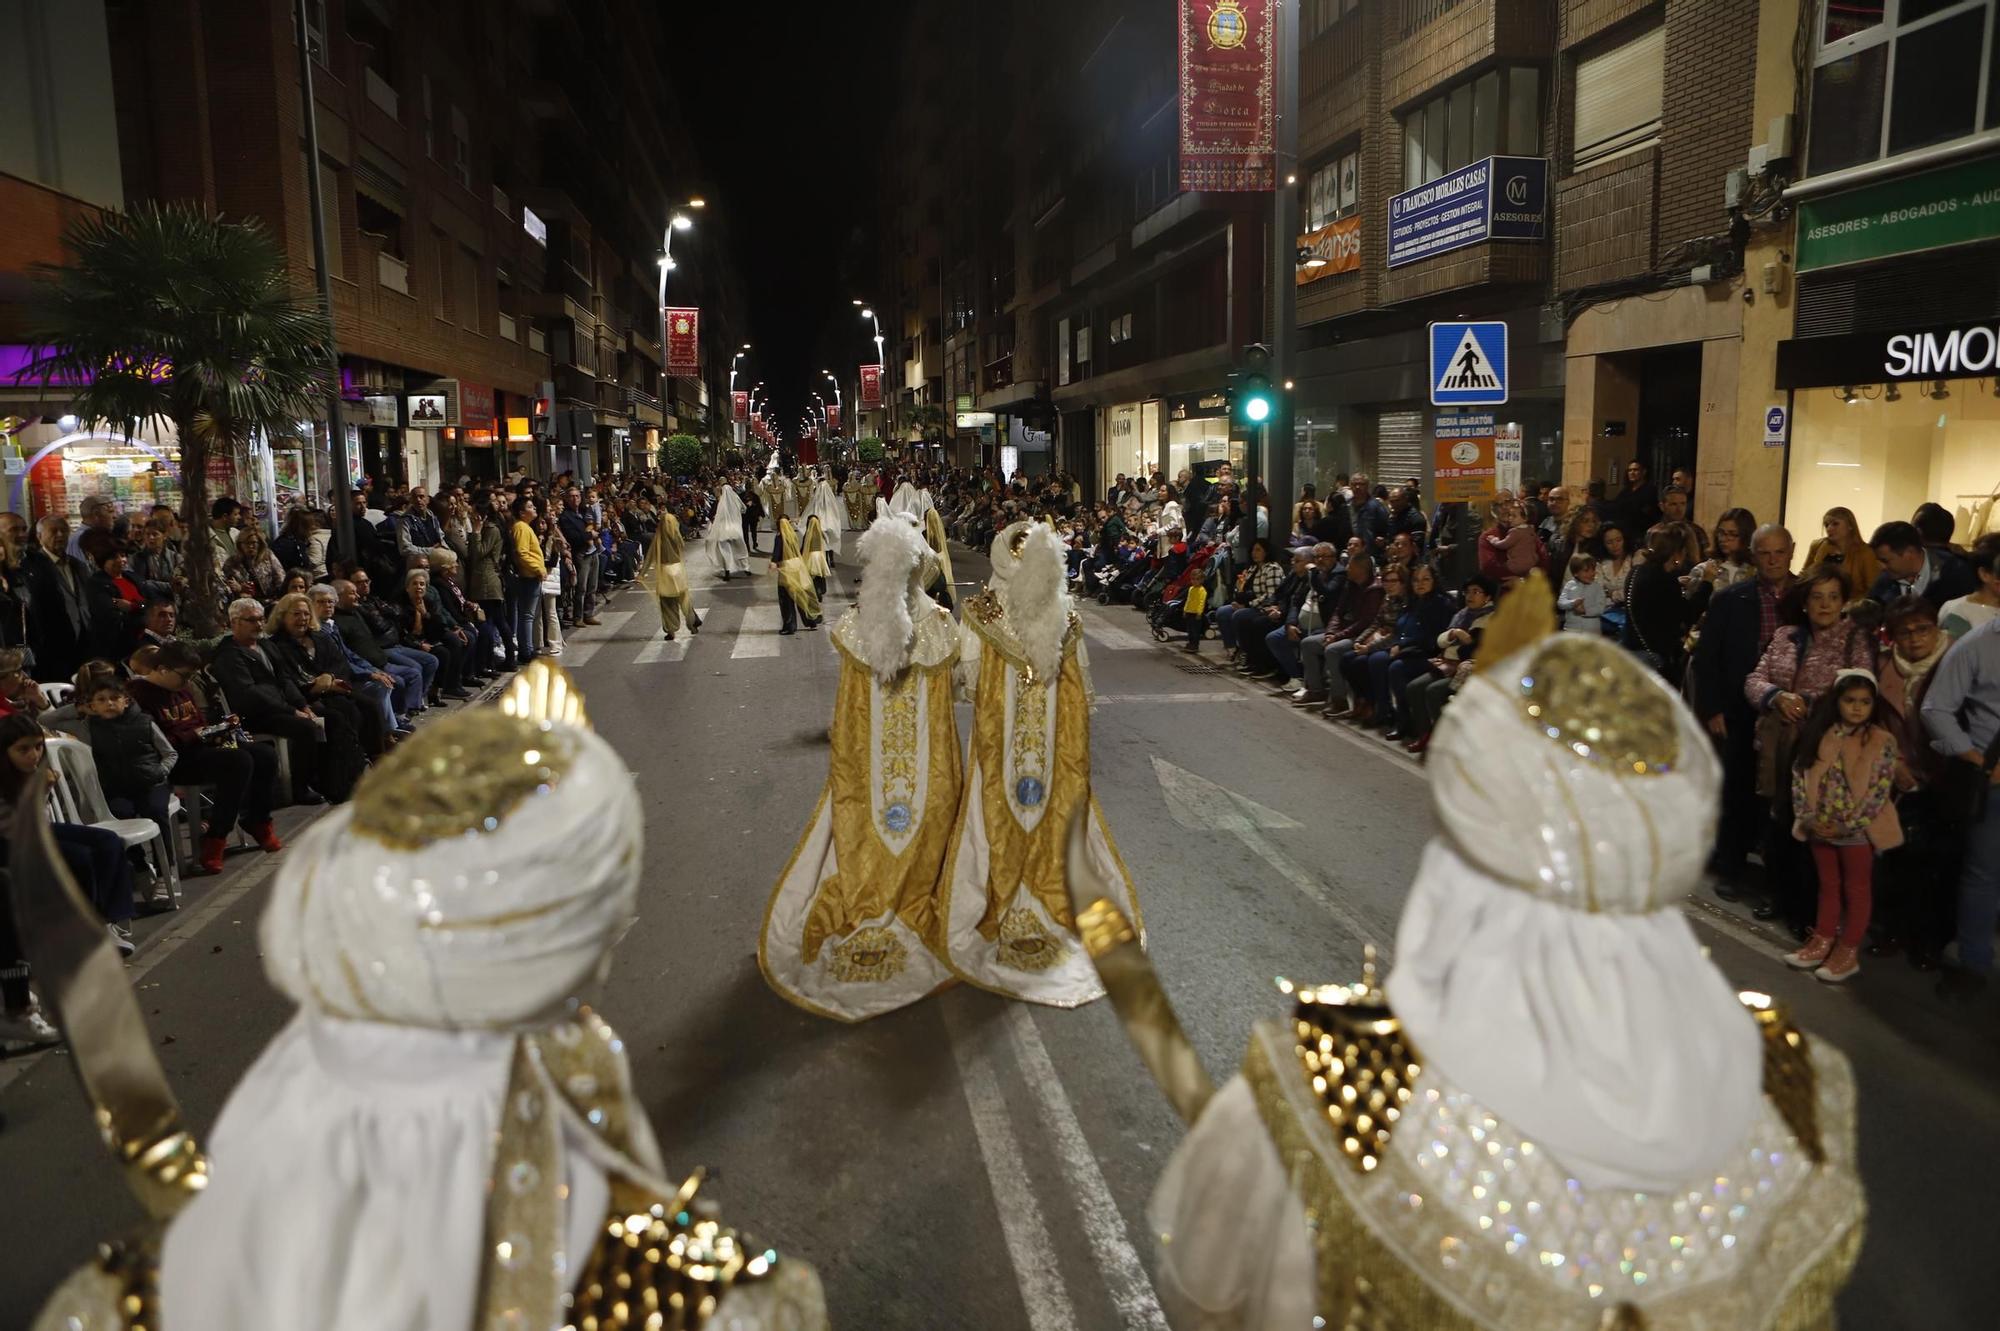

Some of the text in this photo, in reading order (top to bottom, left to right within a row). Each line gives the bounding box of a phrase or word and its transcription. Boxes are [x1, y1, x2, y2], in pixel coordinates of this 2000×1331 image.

[1402, 188, 1435, 214] FRANCISCO
[1435, 175, 1464, 202] MORALES
[1465, 167, 1486, 190] CASAS
[1393, 223, 1412, 239] ESTUDIOS
[1414, 214, 1439, 235] PROYECTOS
[1461, 199, 1484, 216] INTEGRAL
[1493, 212, 1543, 223] ASESORES
[1807, 217, 1869, 241] ASESORES
[1880, 199, 1958, 225] ABOGADOS
[1884, 326, 2000, 377] SIMO
[1435, 426, 1494, 438] CIUDAD DE LORCA
[1769, 415, 1782, 425] ADT
